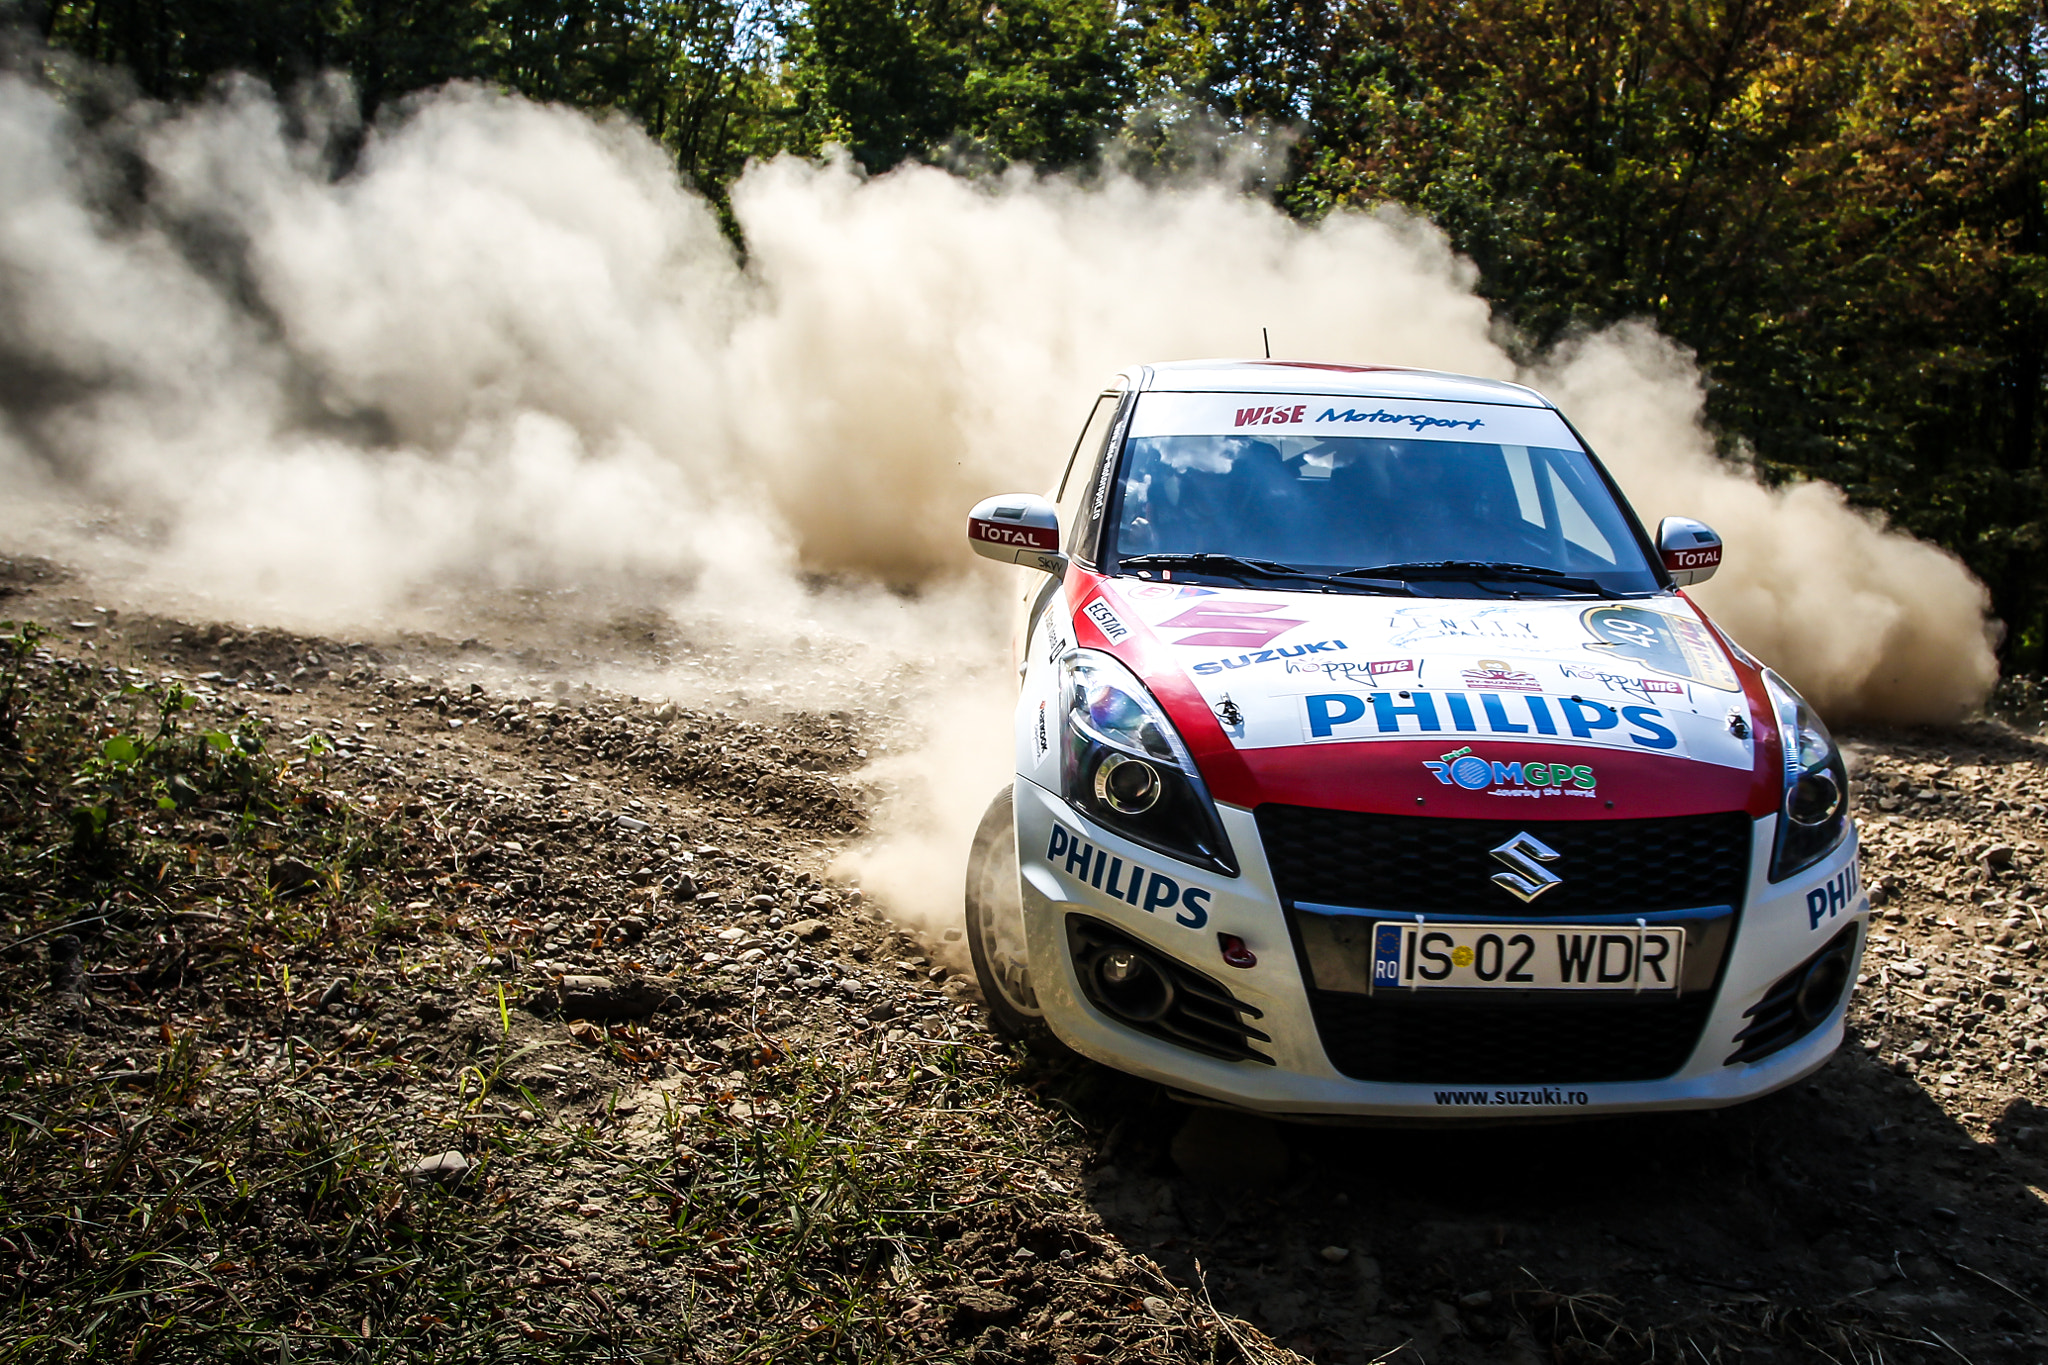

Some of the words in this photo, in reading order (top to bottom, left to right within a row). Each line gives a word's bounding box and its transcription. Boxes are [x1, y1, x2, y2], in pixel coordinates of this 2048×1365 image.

[1234, 405, 1307, 427] WISE
[1315, 408, 1485, 432] Motorsport
[979, 523, 1041, 546] TOTAL
[1674, 551, 1720, 566] TOTAL
[1088, 601, 1128, 643] ECSTAR
[1602, 618, 1660, 649] 49
[1192, 639, 1349, 676] SUZUKI
[1305, 692, 1678, 750] PHILIPS
[1422, 756, 1597, 790] ROMGPS
[1046, 823, 1212, 930] PHILIPS
[1375, 959, 1398, 979] RO
[1404, 932, 1455, 981] IS
[1474, 933, 1536, 983] 02
[1556, 933, 1671, 984] WDR
[1433, 1088, 1589, 1105] www.suzuki.ro
